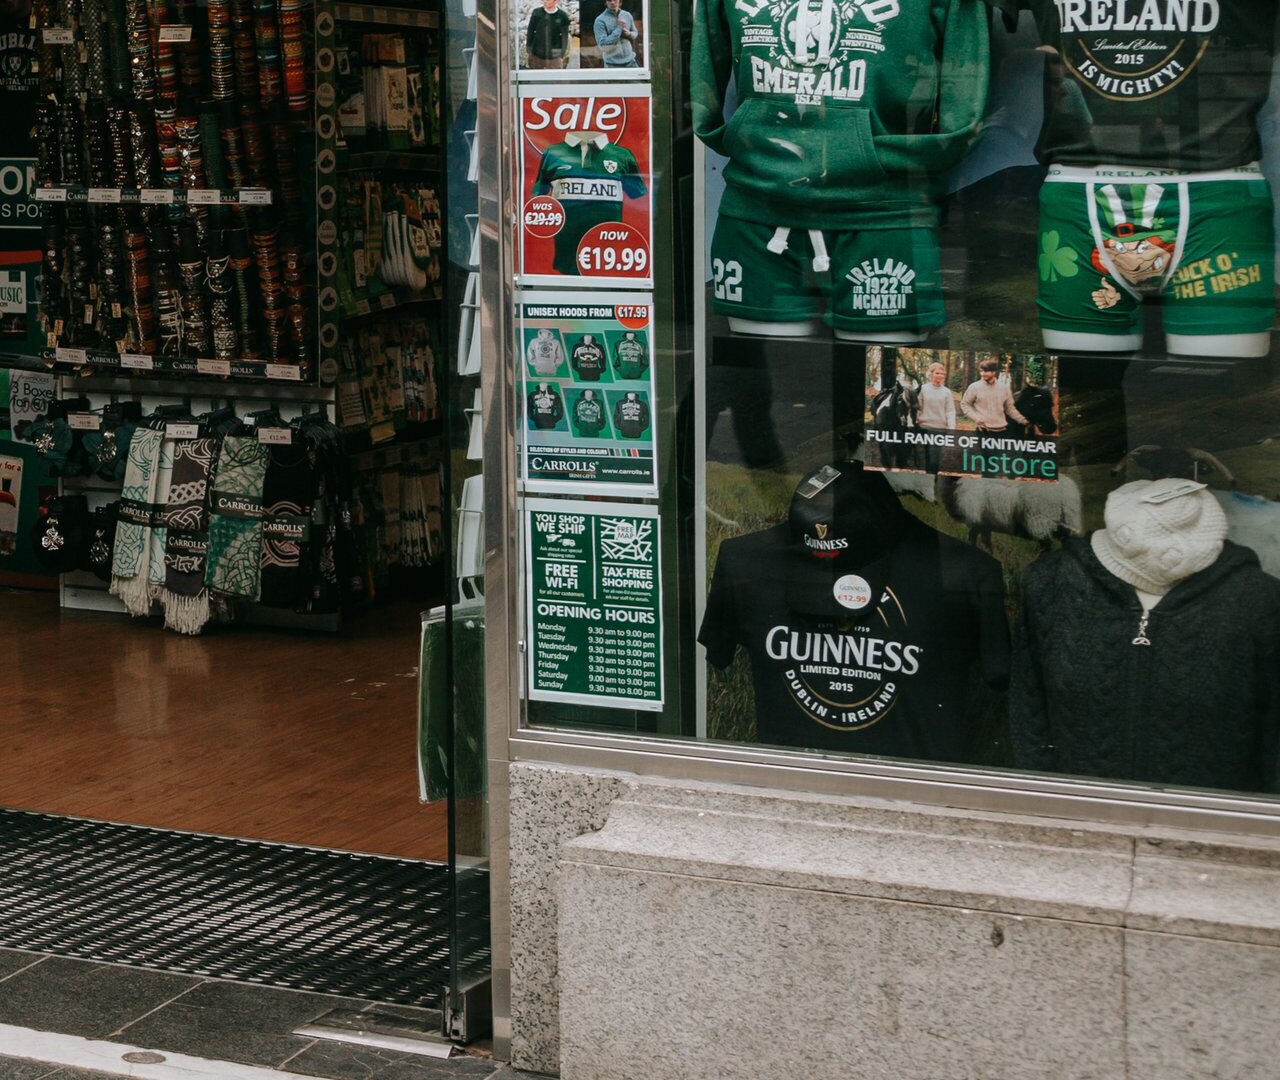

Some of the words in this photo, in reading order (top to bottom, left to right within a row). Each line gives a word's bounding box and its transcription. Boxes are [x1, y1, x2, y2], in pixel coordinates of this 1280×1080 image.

[1115, 53, 1144, 65] 2015
[751, 56, 867, 98] EMERALD
[1077, 59, 1095, 81] IS
[1096, 59, 1185, 95] MIGHTY!
[795, 95, 822, 105] ISLE
[526, 97, 622, 131] Sale
[532, 203, 553, 211] was
[525, 212, 562, 226] €29.99
[600, 230, 629, 241] now
[578, 246, 647, 271] €19.99
[845, 258, 916, 285] IRELAND
[713, 257, 743, 303] 22
[864, 277, 899, 294] 1922
[1173, 278, 1207, 300] THE
[1211, 265, 1261, 294] IRISH
[853, 293, 907, 309] MCMXXII
[527, 307, 558, 317] UNISEX
[559, 307, 588, 317] HOODS
[590, 308, 613, 317] FROM
[618, 306, 647, 318] €17.99
[866, 429, 902, 443] FULL
[904, 432, 954, 447] RANGE
[958, 435, 978, 448] OF
[981, 437, 1056, 454] KNITWEAR
[5, 460, 15, 470] for
[531, 457, 597, 472] CARROLLS
[962, 448, 1056, 477] Instore
[535, 514, 556, 523] YOU
[559, 514, 585, 524] SHOP
[536, 523, 555, 533] WE
[558, 523, 585, 535] SHIP
[804, 533, 848, 551] GUINNESS
[545, 563, 579, 578] FREE
[602, 566, 653, 580] TAX-FREE
[545, 576, 579, 590] WI-FI
[602, 577, 654, 590] SHOPPING
[537, 604, 602, 620] OPENING
[605, 609, 656, 625] HOURS
[537, 622, 566, 632] Monday
[537, 632, 566, 642] Tuesday
[537, 641, 578, 652] Wednesday
[765, 625, 920, 675] GUINNESS
[800, 664, 840, 676] LIMITED
[841, 667, 881, 681] EDITION
[829, 681, 853, 693] 2015
